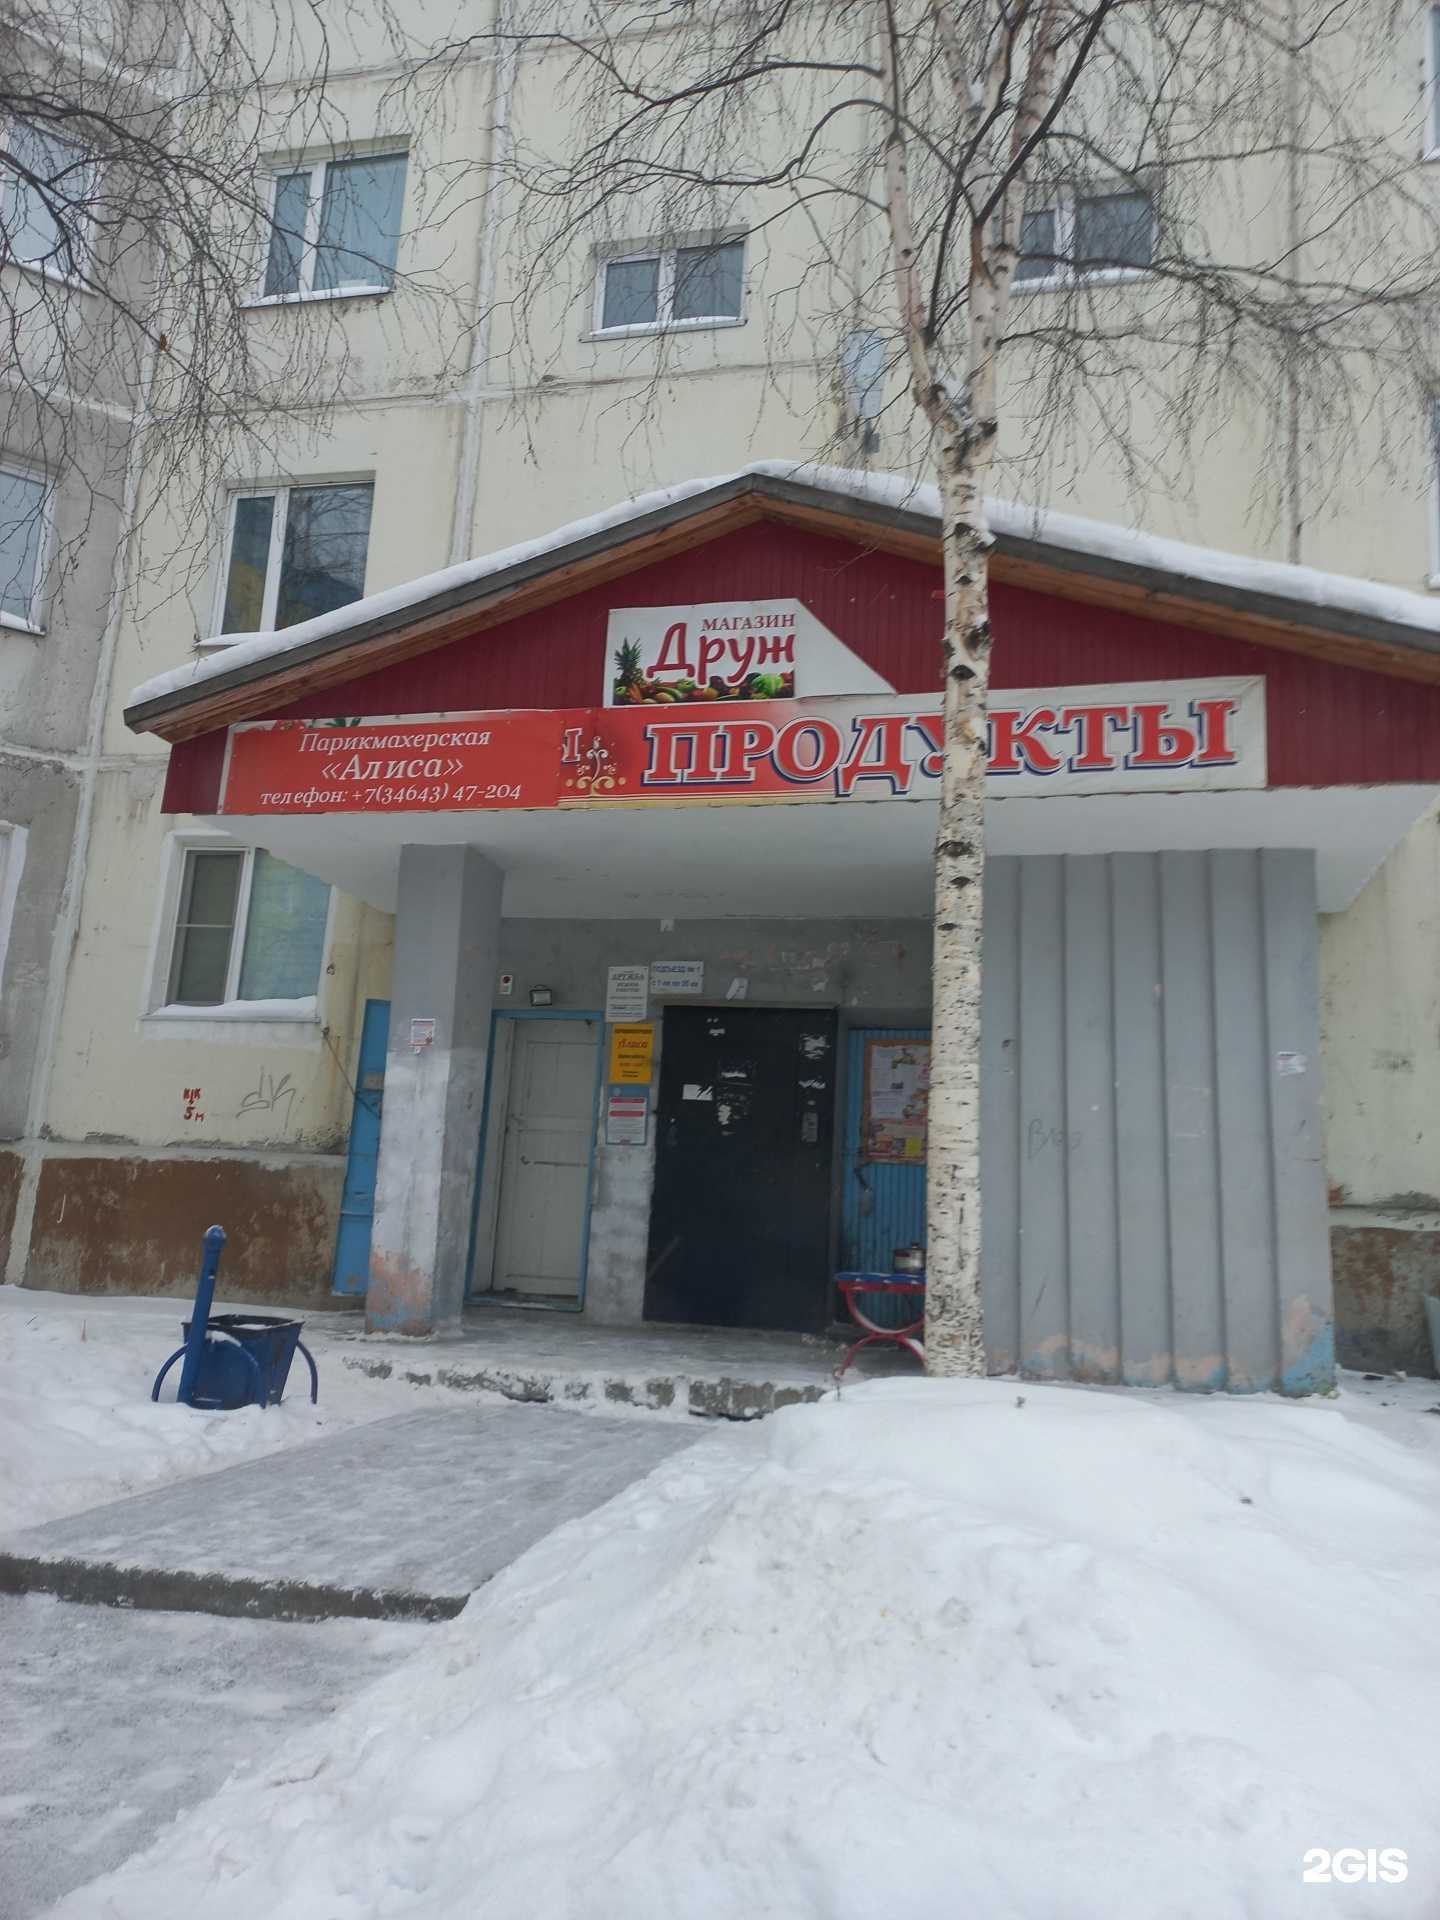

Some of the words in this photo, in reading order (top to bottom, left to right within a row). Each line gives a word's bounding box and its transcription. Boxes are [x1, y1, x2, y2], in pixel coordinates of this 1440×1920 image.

[702, 614, 796, 631] МАГАЗИН
[646, 622, 797, 686] Друж
[299, 730, 492, 756] Парикмахерская
[321, 754, 465, 781] «Алиса»
[260, 787, 347, 808] телефон:
[352, 783, 449, 805] +7(34643)
[453, 783, 522, 801] 47-204
